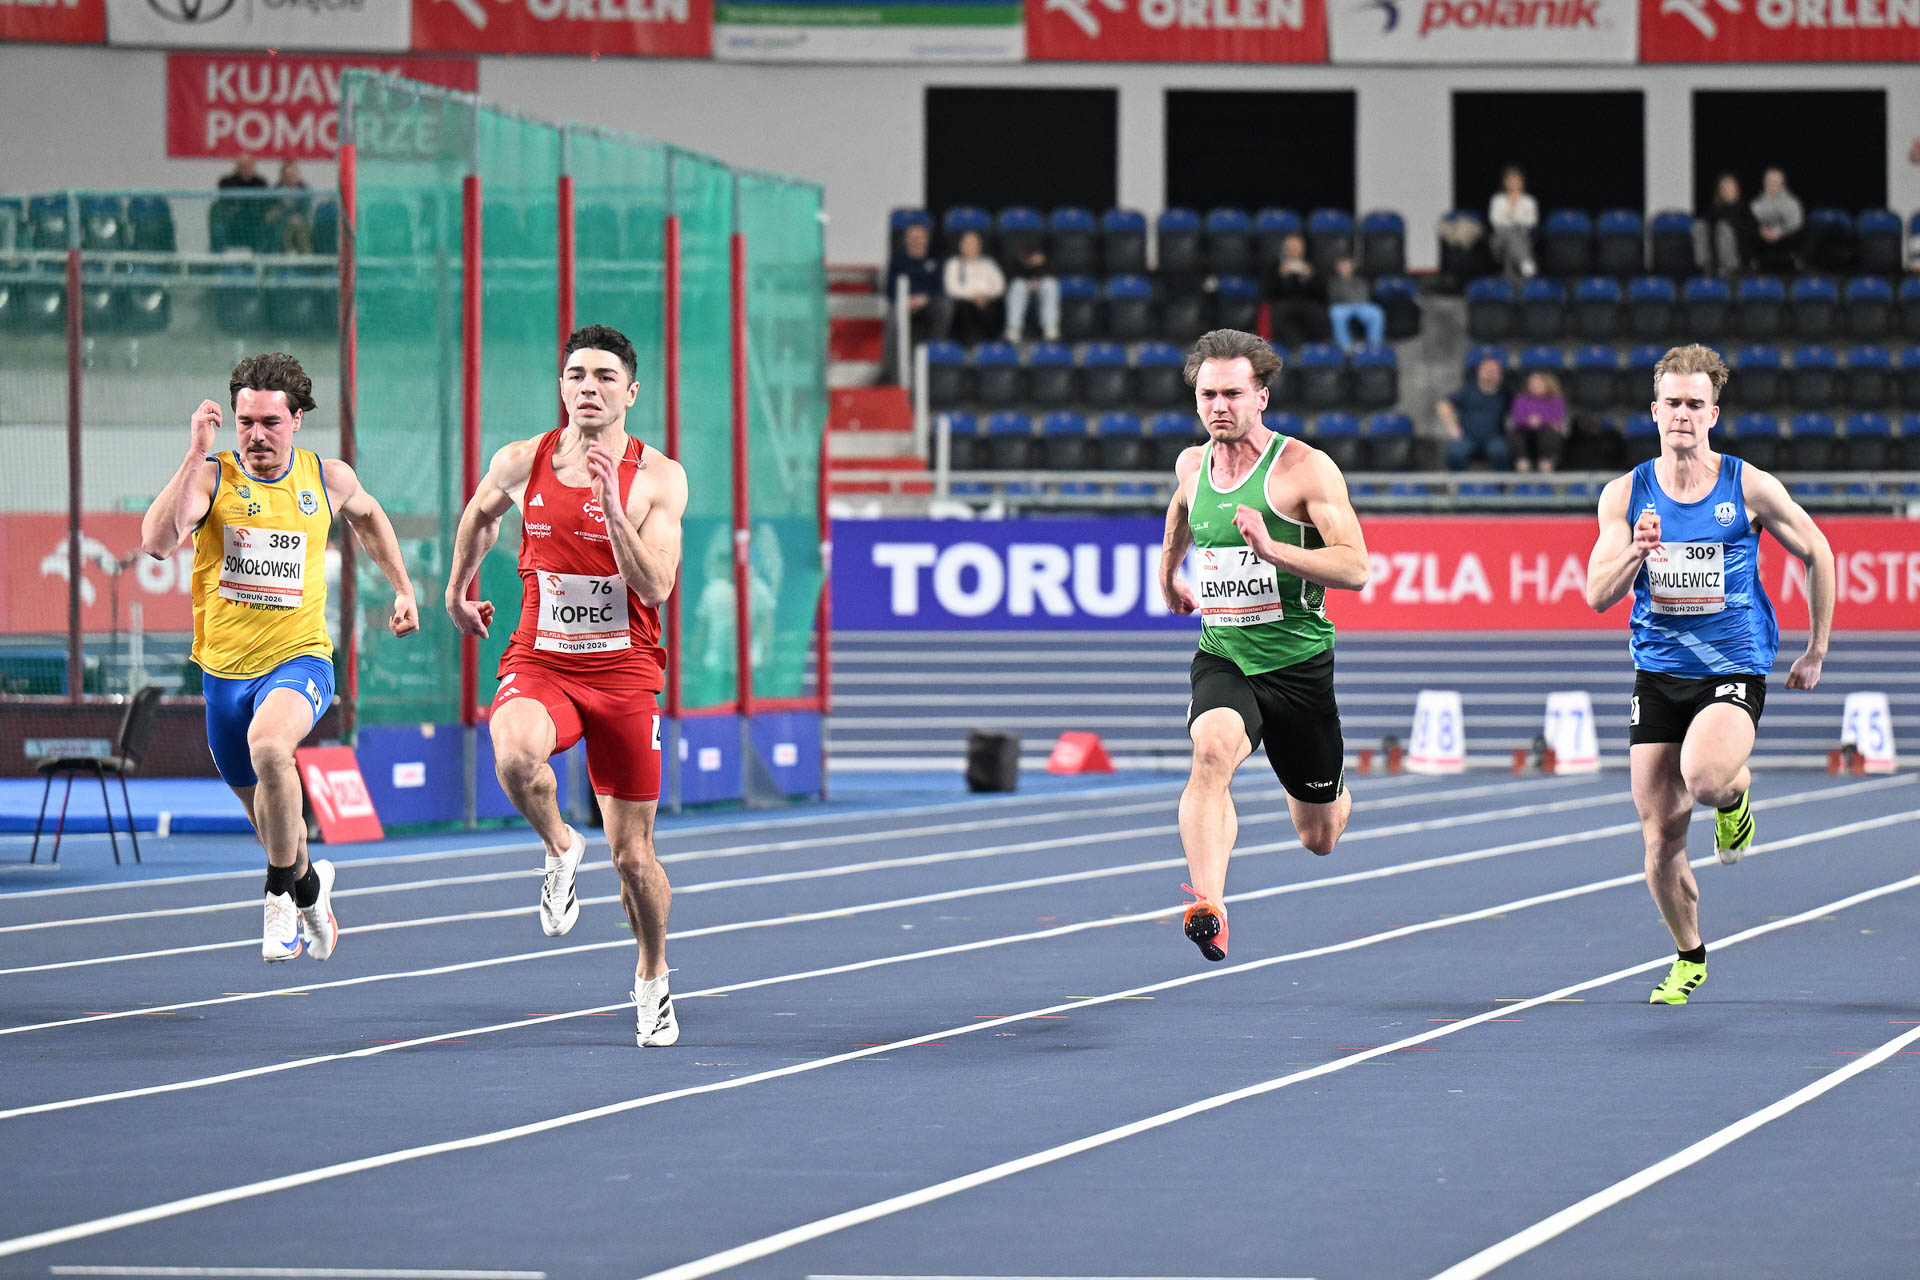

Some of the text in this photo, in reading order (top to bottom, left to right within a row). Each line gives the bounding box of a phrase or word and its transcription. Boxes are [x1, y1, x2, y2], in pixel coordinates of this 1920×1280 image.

[1139, 0, 1304, 30] ORLEN
[1754, 0, 1920, 29] ORLEN
[269, 534, 301, 549] 389
[1238, 550, 1261, 566] 71
[1685, 546, 1716, 560] 309
[224, 555, 301, 579] SOKOŁOWSKI
[589, 580, 613, 595] 76
[1200, 576, 1274, 598] LEMPACH
[1359, 552, 1494, 604] PZLA
[1650, 570, 1720, 588] SAMULEWICZ
[236, 592, 283, 603] TORUŃ 2026
[551, 603, 613, 624] KOPEĆ
[1661, 605, 1685, 613] TORUŃ
[1240, 615, 1261, 623] 2026
[558, 641, 607, 651] TORUŃ 2026
[1438, 710, 1456, 752] 8
[1570, 710, 1584, 753] 7
[1869, 710, 1885, 752] 5
